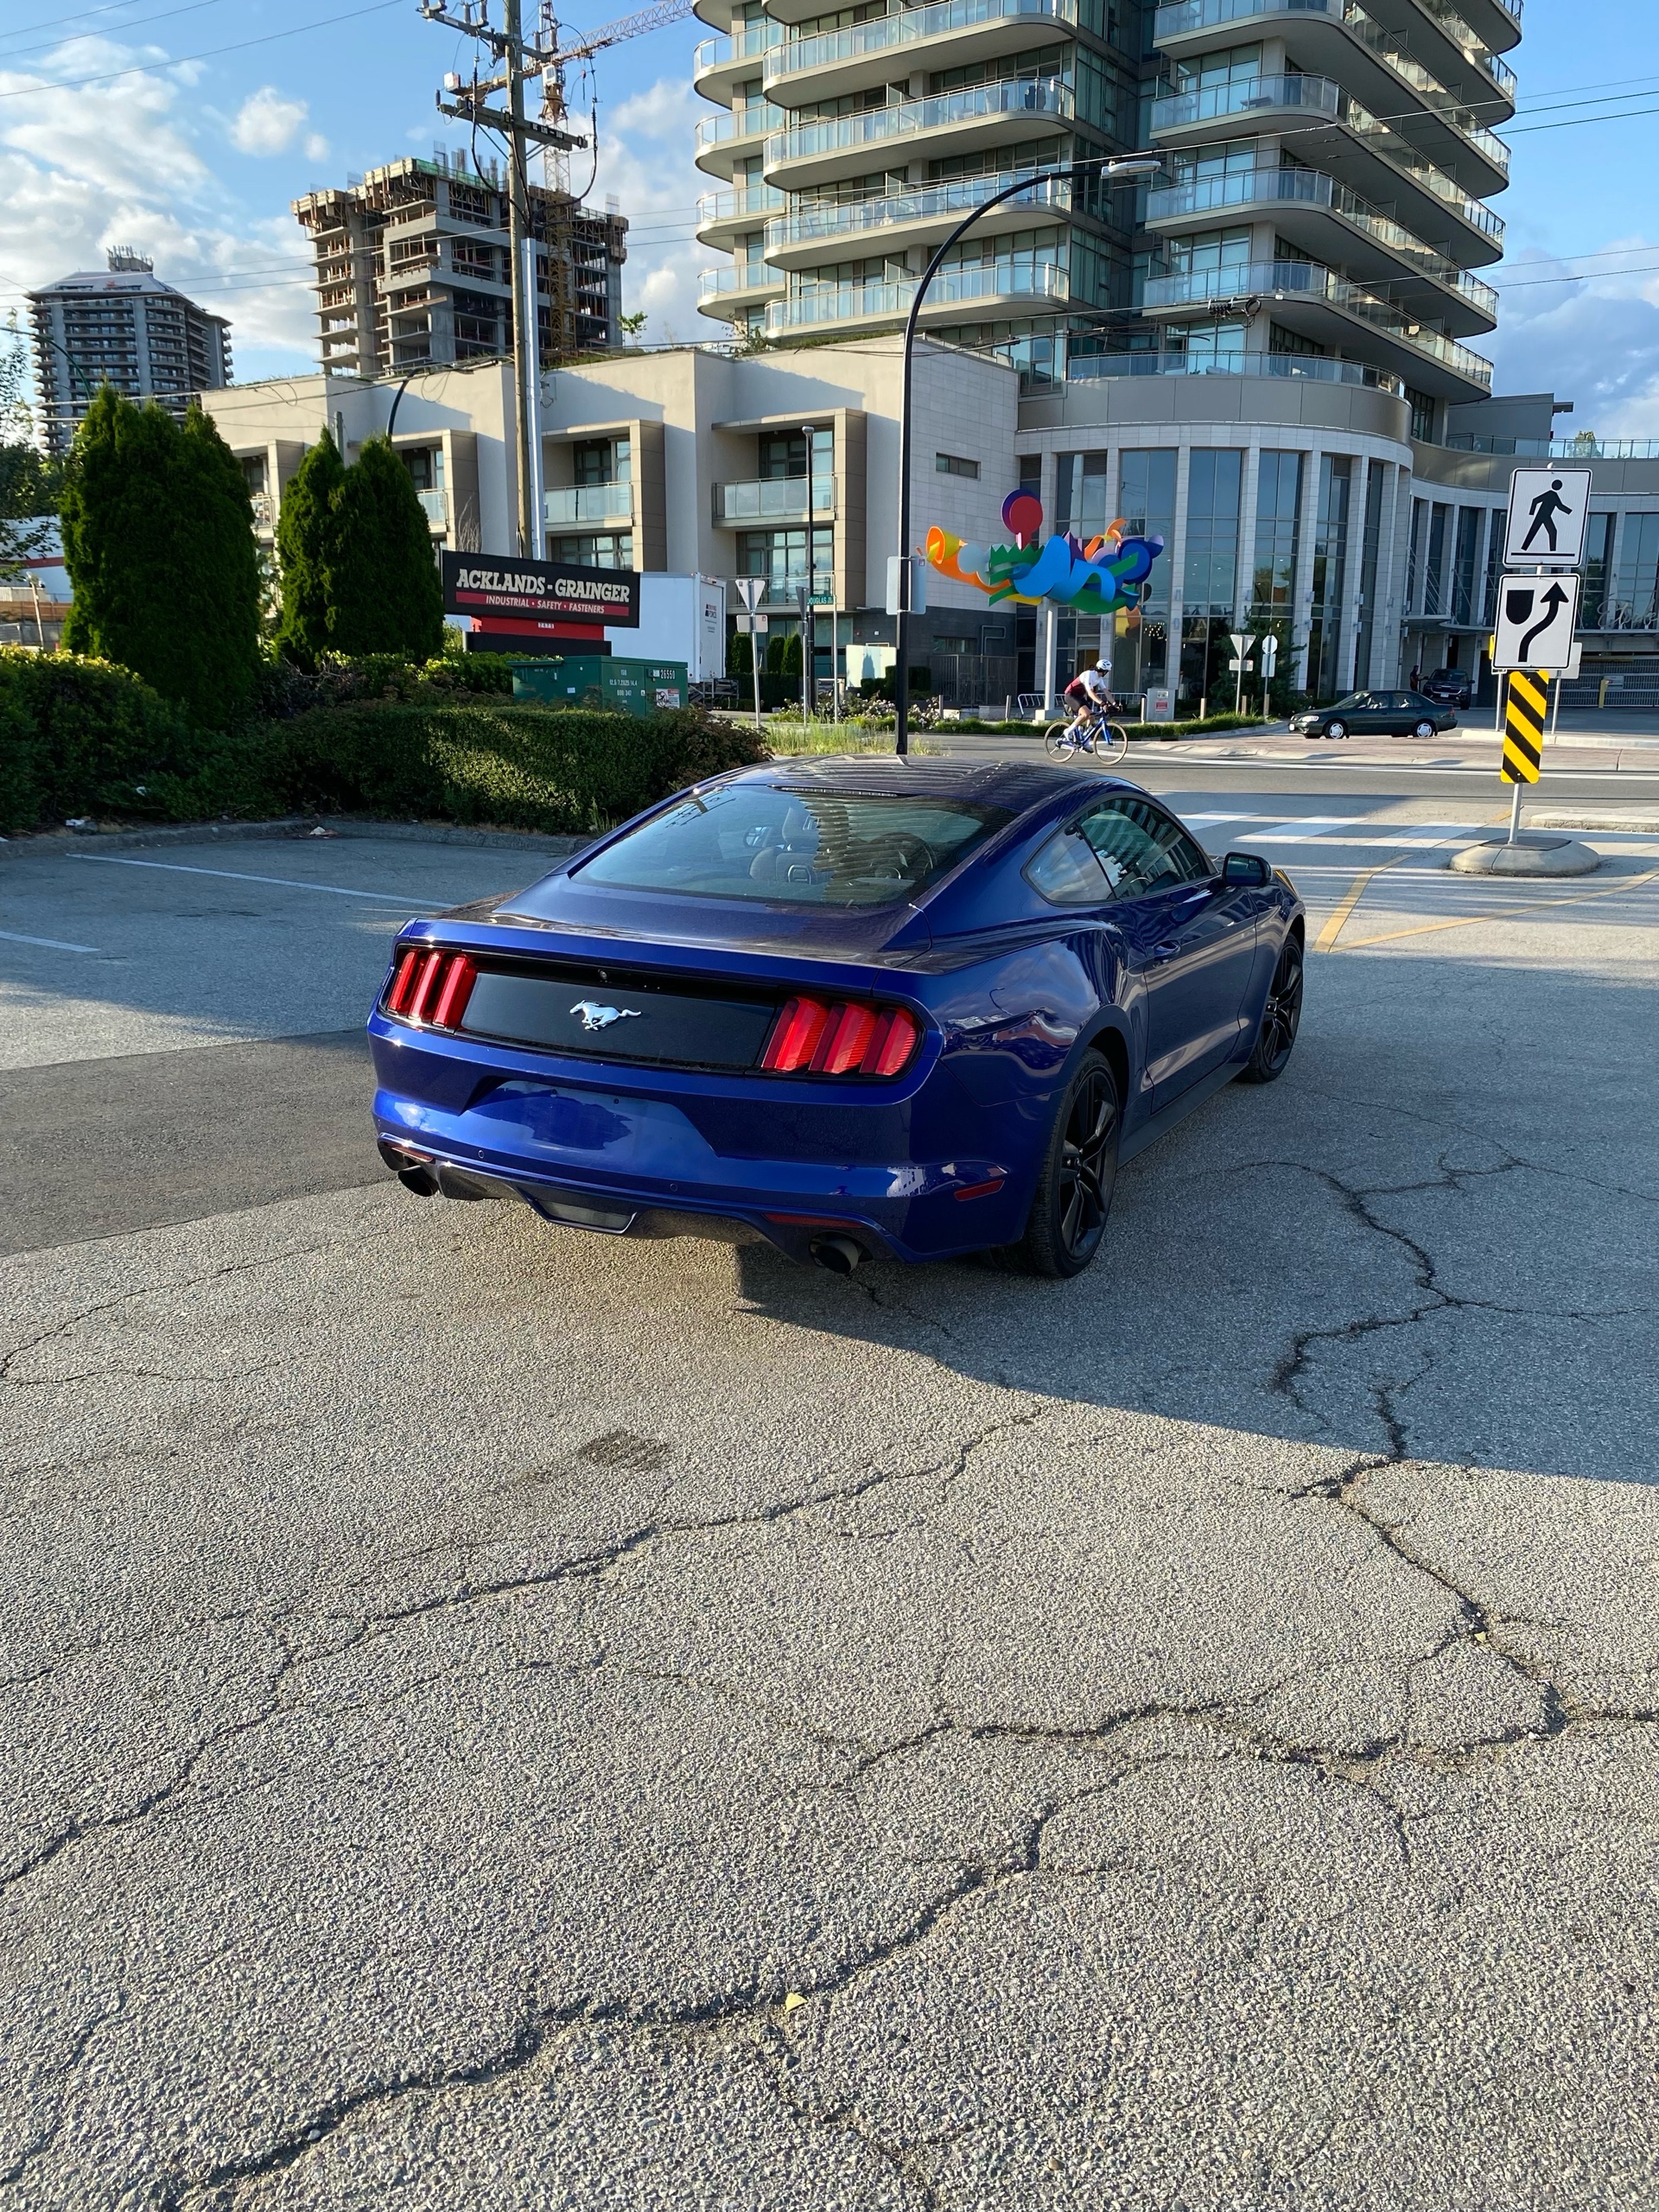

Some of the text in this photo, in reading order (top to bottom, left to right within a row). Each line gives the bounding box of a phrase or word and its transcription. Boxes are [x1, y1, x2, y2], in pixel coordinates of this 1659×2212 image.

[486, 595, 605, 614] INDUSTRIAL SAFETY FASTENERS
[660, 669, 676, 679] 26550
